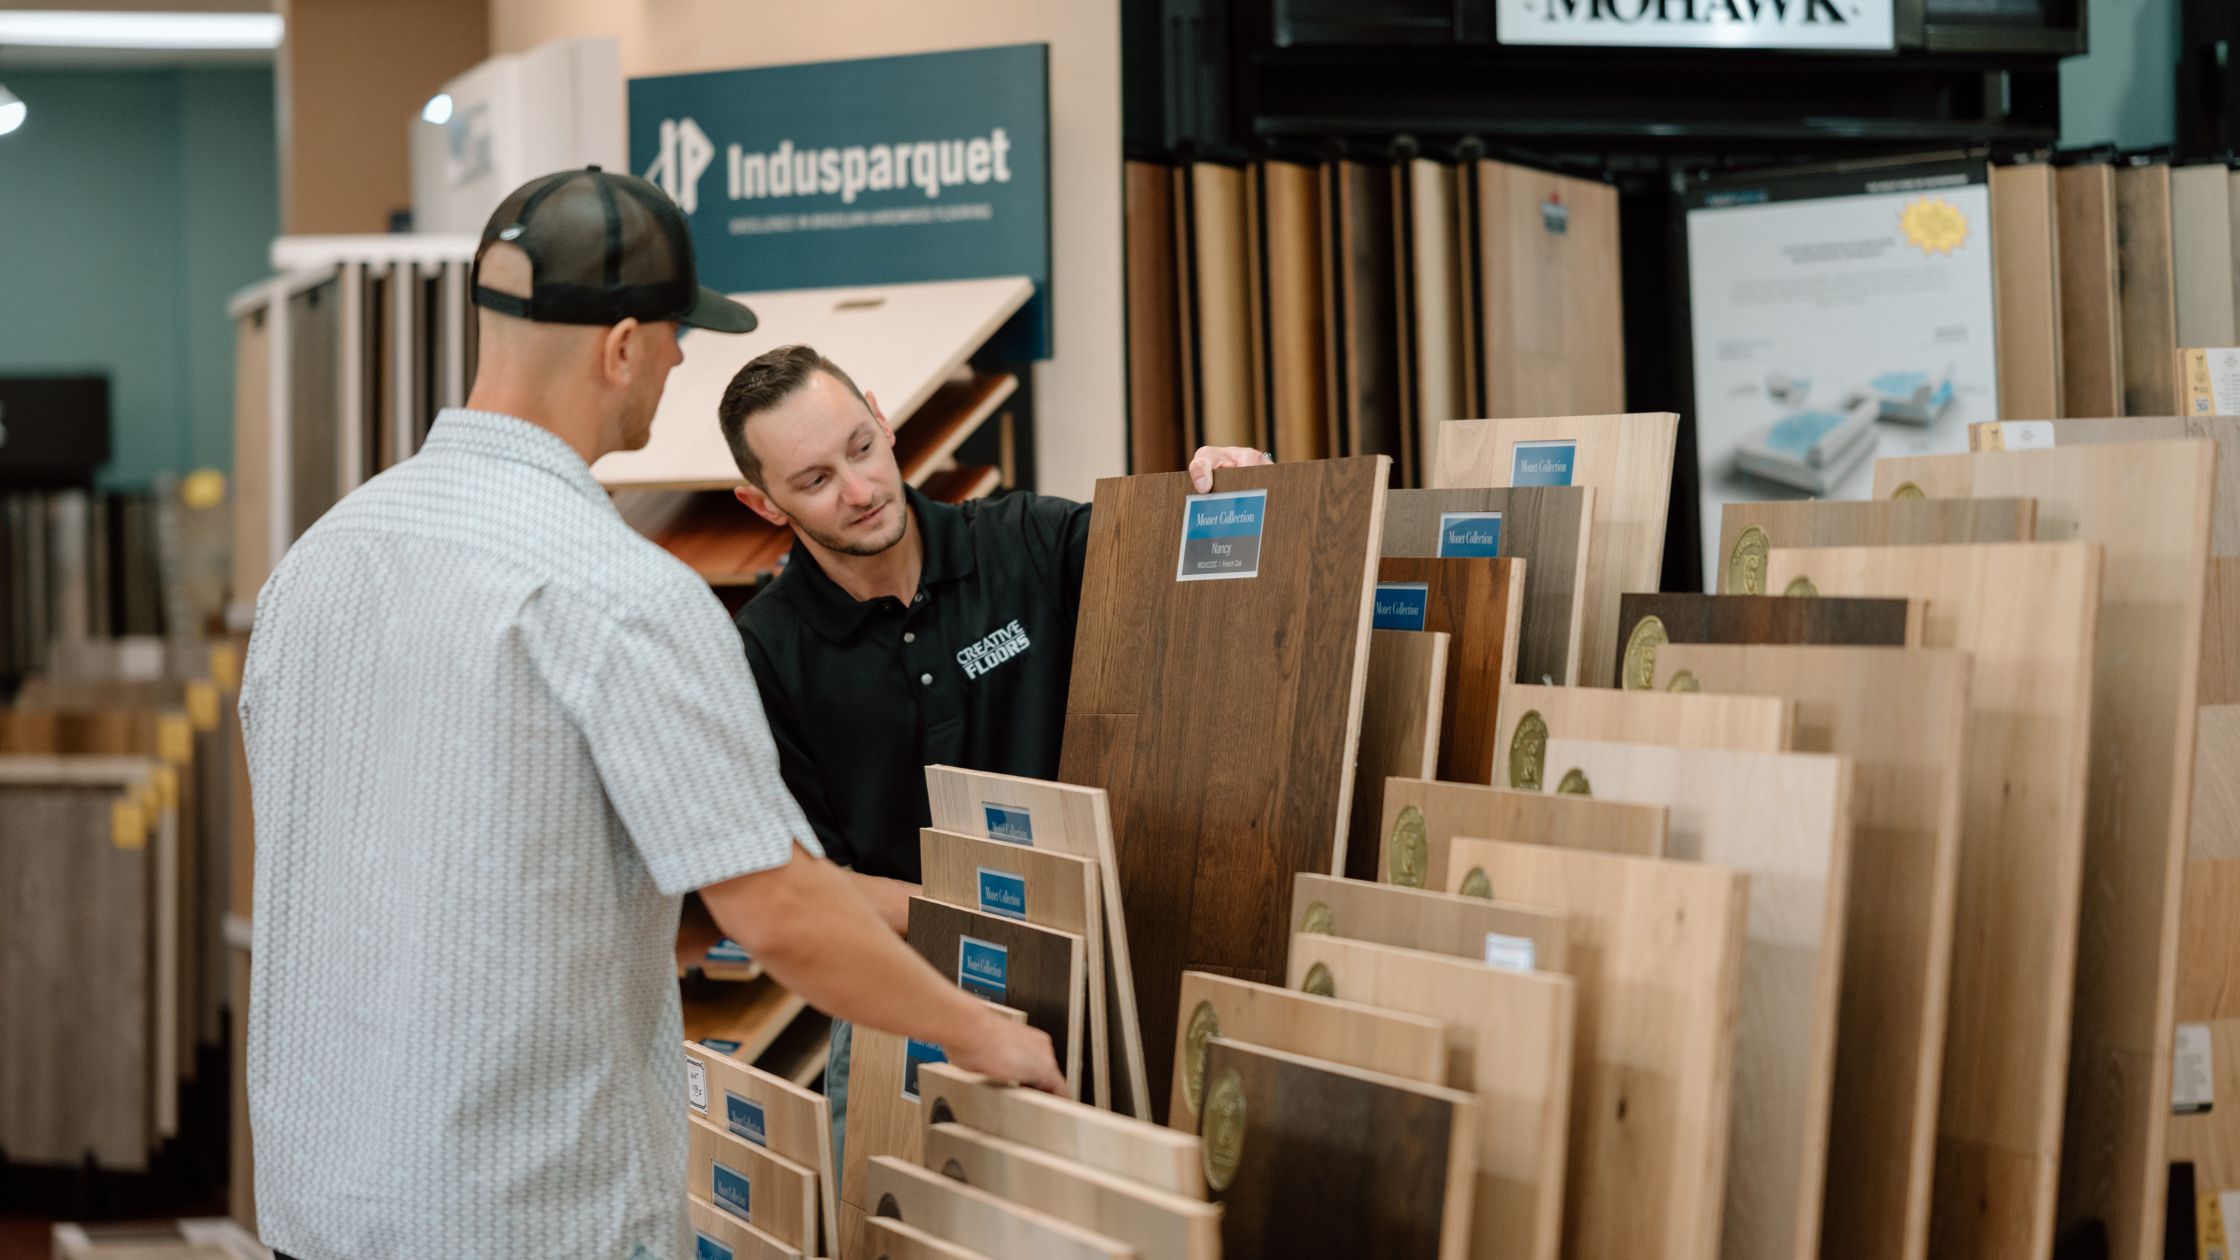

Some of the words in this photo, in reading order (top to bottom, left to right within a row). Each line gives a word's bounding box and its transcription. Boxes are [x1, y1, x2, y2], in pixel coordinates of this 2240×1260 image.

[1543, 0, 1848, 24] MOHAWK
[727, 127, 1012, 204] Indusparquet
[1521, 459, 1537, 473] Monet
[1538, 458, 1568, 473] Collection
[1197, 512, 1218, 526] Monet
[1219, 509, 1255, 525] Collection
[1448, 531, 1465, 545] Monet
[1465, 530, 1493, 545] Collection
[1211, 542, 1232, 557] Nancy
[1376, 601, 1392, 615] Monet
[1392, 601, 1419, 616] Collection
[956, 619, 1024, 665] CREATIVE
[964, 633, 1031, 680] FLOORS
[984, 885, 999, 902] Monet
[999, 888, 1021, 907] Collection
[967, 955, 980, 972] Monet
[980, 958, 1002, 978] Collection
